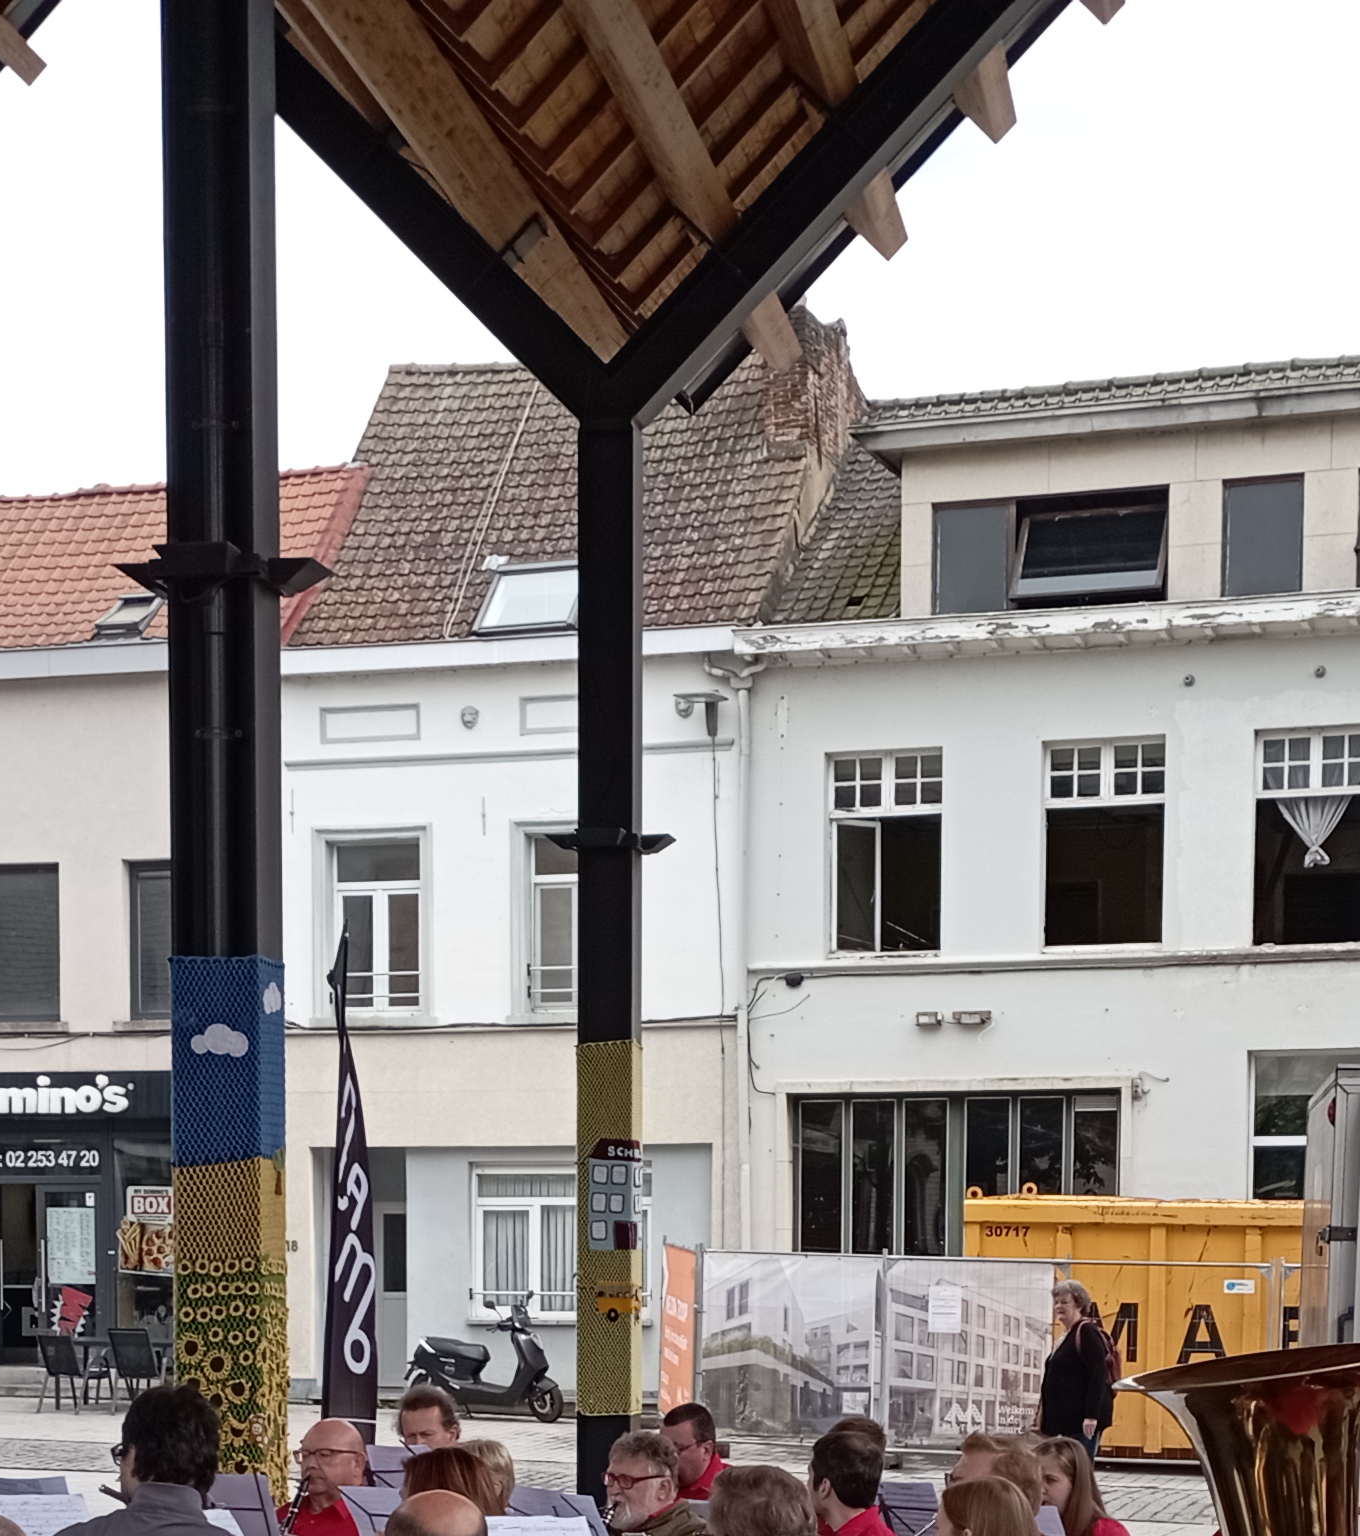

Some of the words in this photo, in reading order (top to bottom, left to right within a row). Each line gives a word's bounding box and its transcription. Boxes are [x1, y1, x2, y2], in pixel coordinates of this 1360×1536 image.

[5, 1150, 25, 1168] 02
[27, 1150, 55, 1168] 253
[57, 1150, 77, 1168] 47
[80, 1150, 99, 1168] 20
[133, 1196, 169, 1213] BOX
[985, 1225, 1031, 1237] 30717
